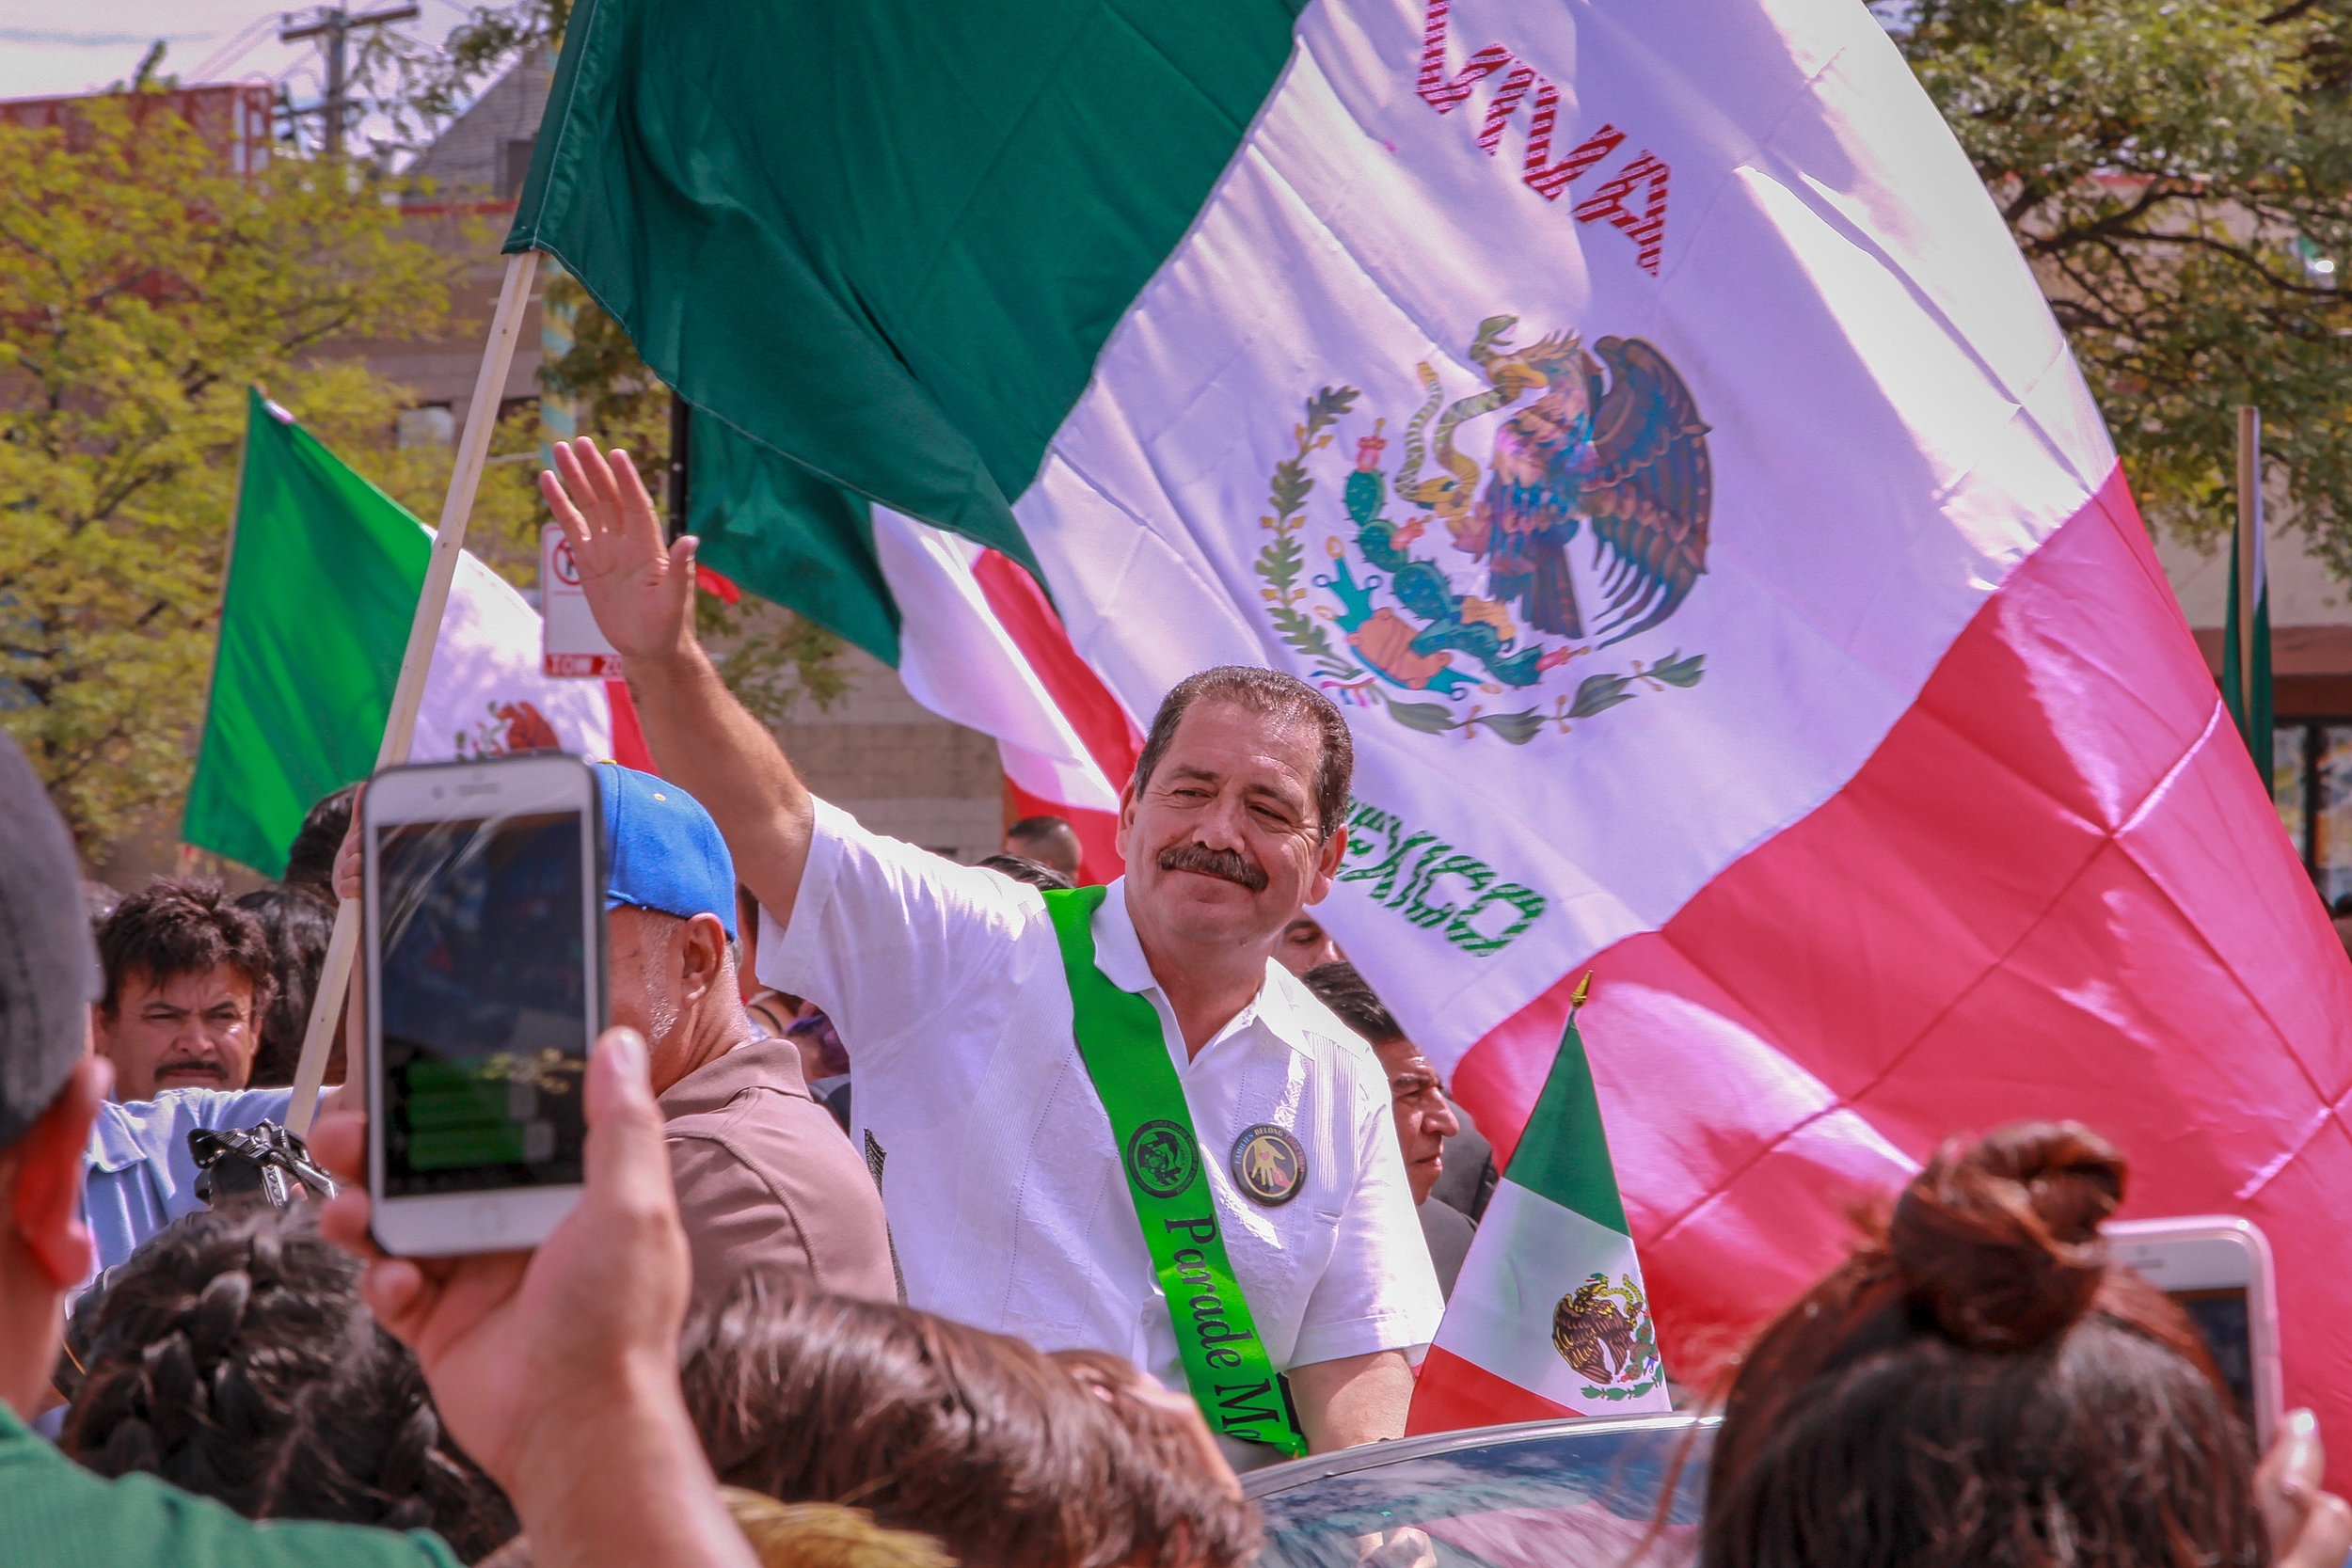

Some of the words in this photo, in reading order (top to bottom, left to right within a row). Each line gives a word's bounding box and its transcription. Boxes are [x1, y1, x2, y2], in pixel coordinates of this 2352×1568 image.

[1416, 0, 1671, 276] VIVA
[549, 656, 593, 675] TOW
[1337, 797, 1549, 958] EXICO
[1234, 1132, 1254, 1164] FAMILIES
[1254, 1127, 1283, 1137] BELONG
[1164, 1213, 1253, 1370] Parade
